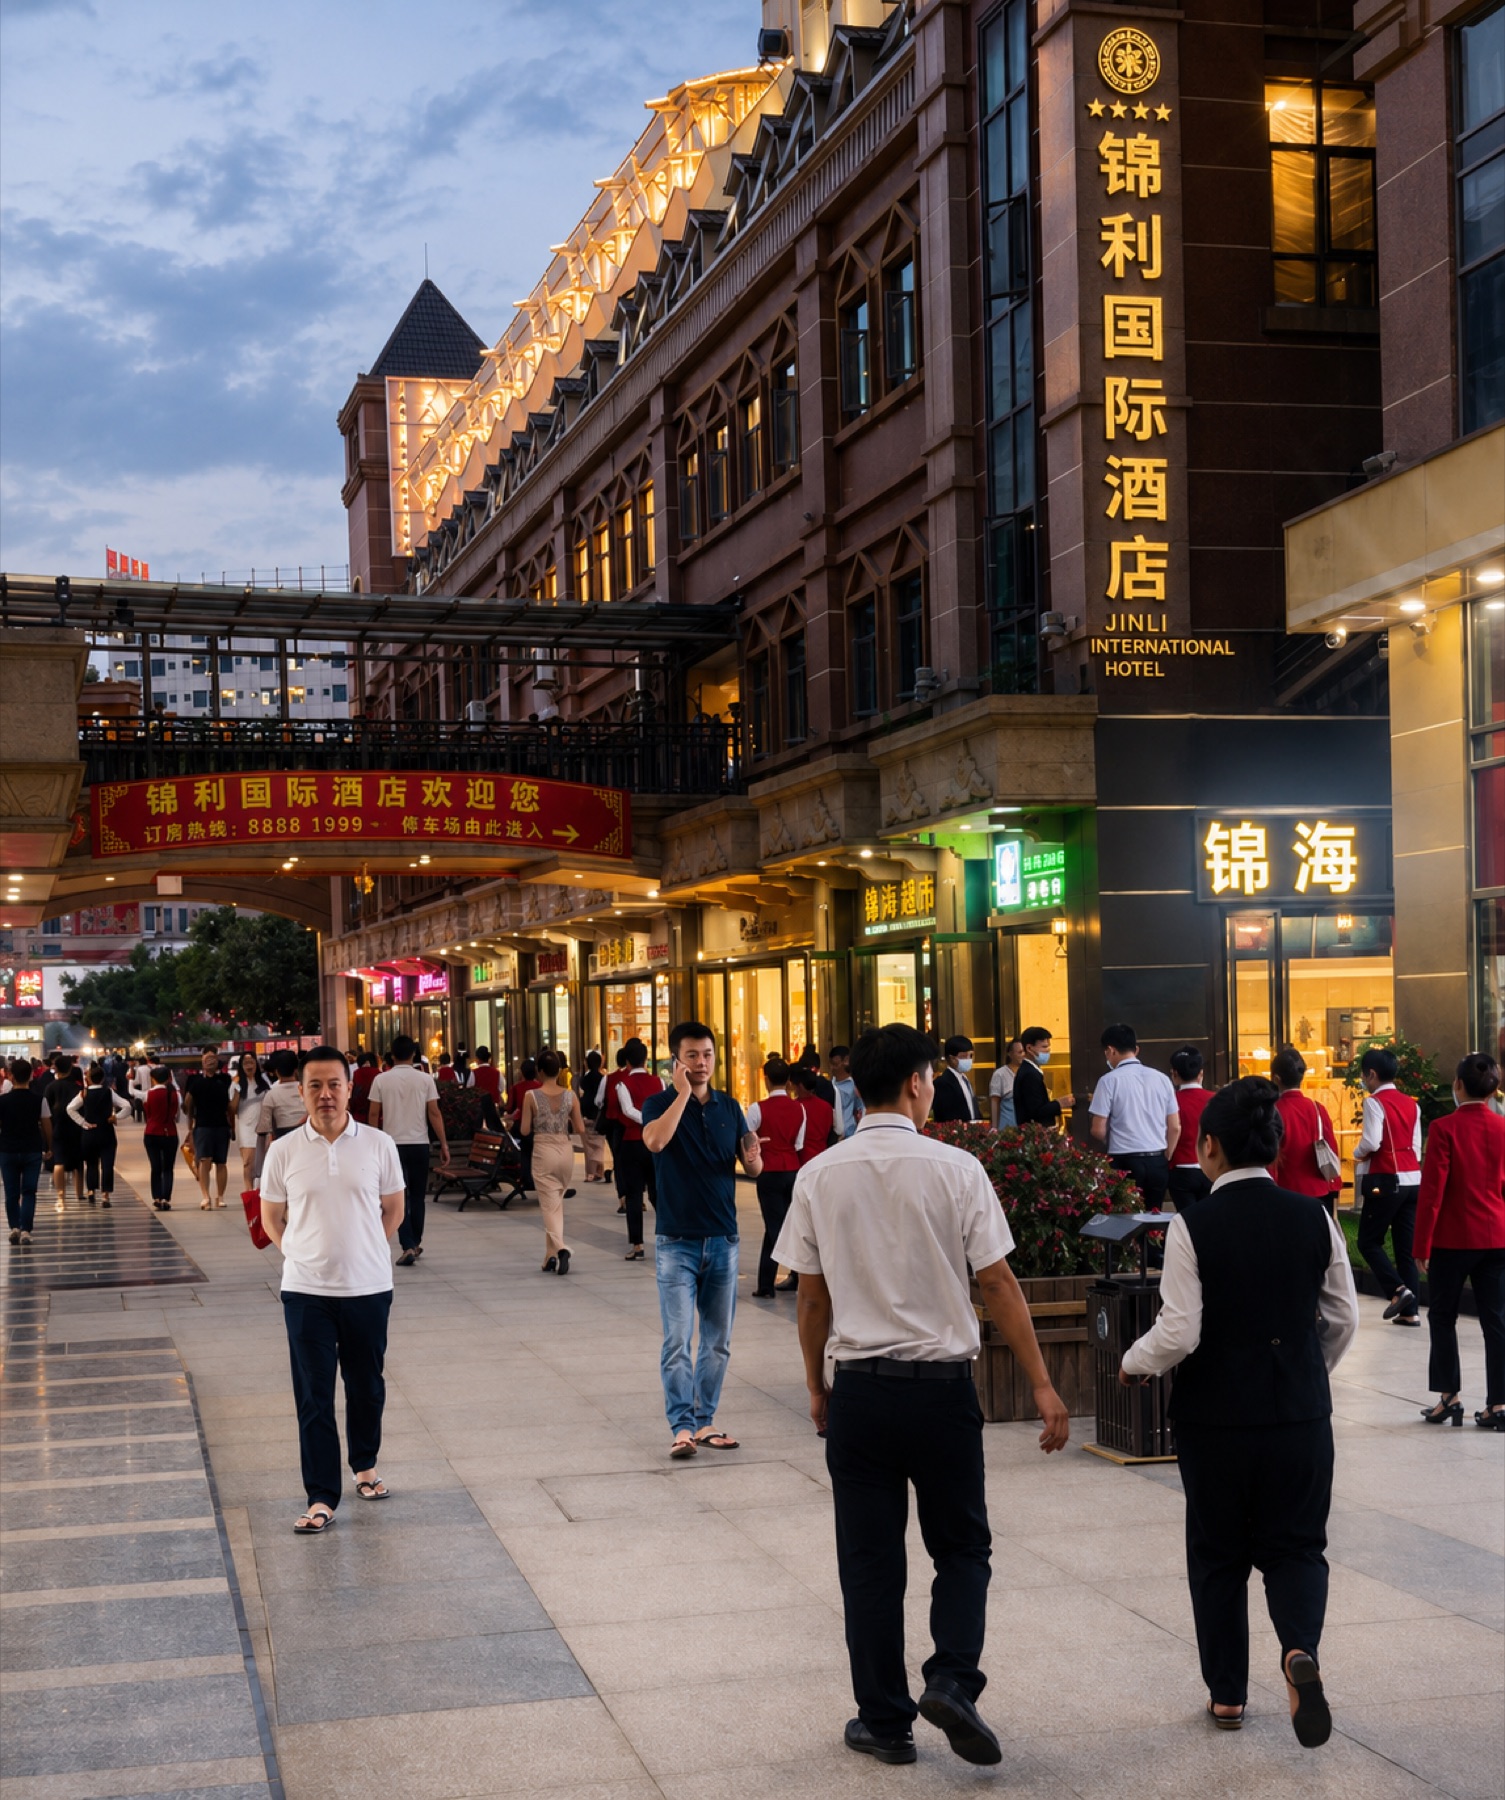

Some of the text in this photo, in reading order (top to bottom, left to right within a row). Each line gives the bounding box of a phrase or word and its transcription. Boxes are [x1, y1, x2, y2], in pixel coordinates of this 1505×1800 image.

[1098, 130, 1170, 601] 锦利国际酒店
[1105, 613, 1168, 633] JINLI
[1090, 637, 1236, 656] INTERNATIONAL
[1104, 660, 1166, 677] HOTEL
[146, 776, 541, 816] 锦利国际酒店欢迎您
[248, 817, 300, 835] 8888
[312, 816, 363, 833] 1999
[1204, 820, 1359, 896] 锦海
[865, 874, 935, 922] 锦海超市
